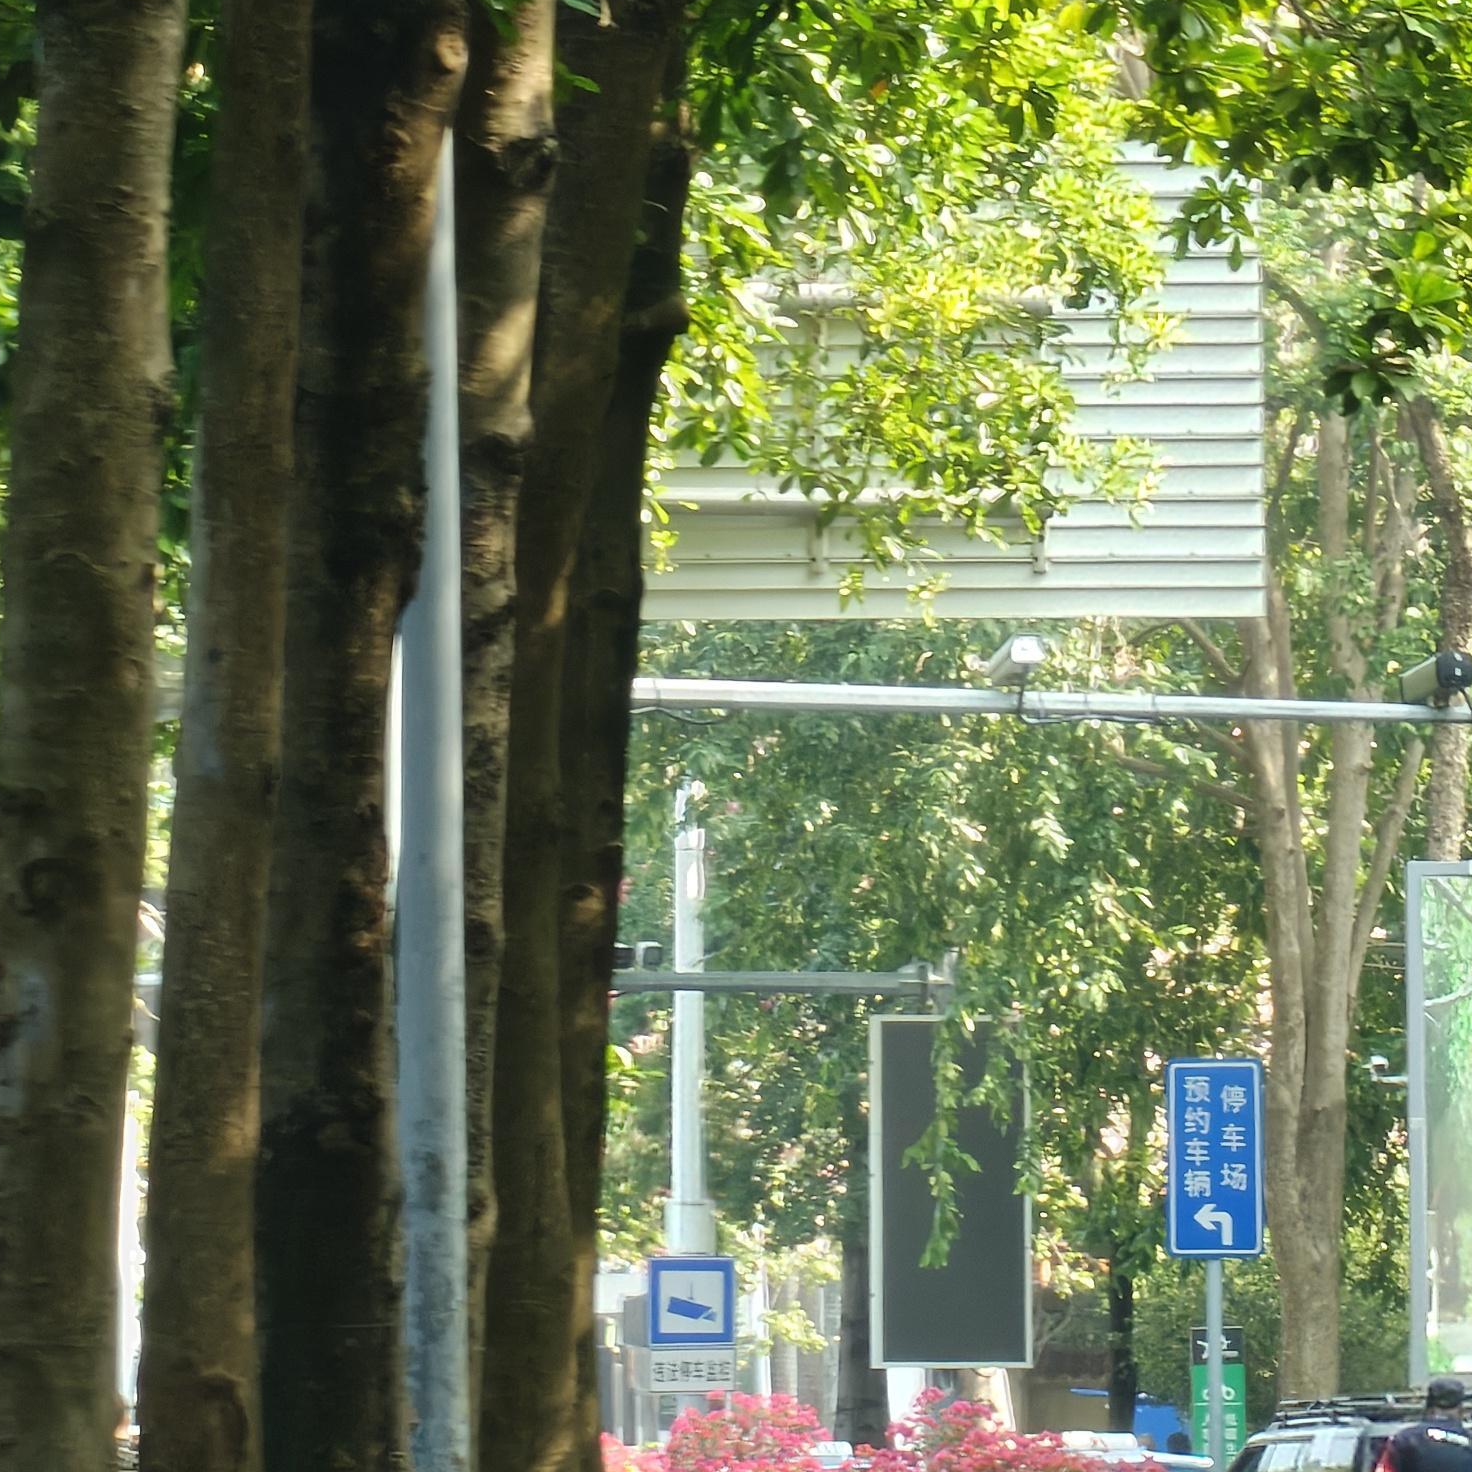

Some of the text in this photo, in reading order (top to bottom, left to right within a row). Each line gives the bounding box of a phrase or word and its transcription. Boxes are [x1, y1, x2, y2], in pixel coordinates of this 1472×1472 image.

[1183, 1076, 1212, 1198] 预约车辆
[1219, 1084, 1248, 1192] 停车场
